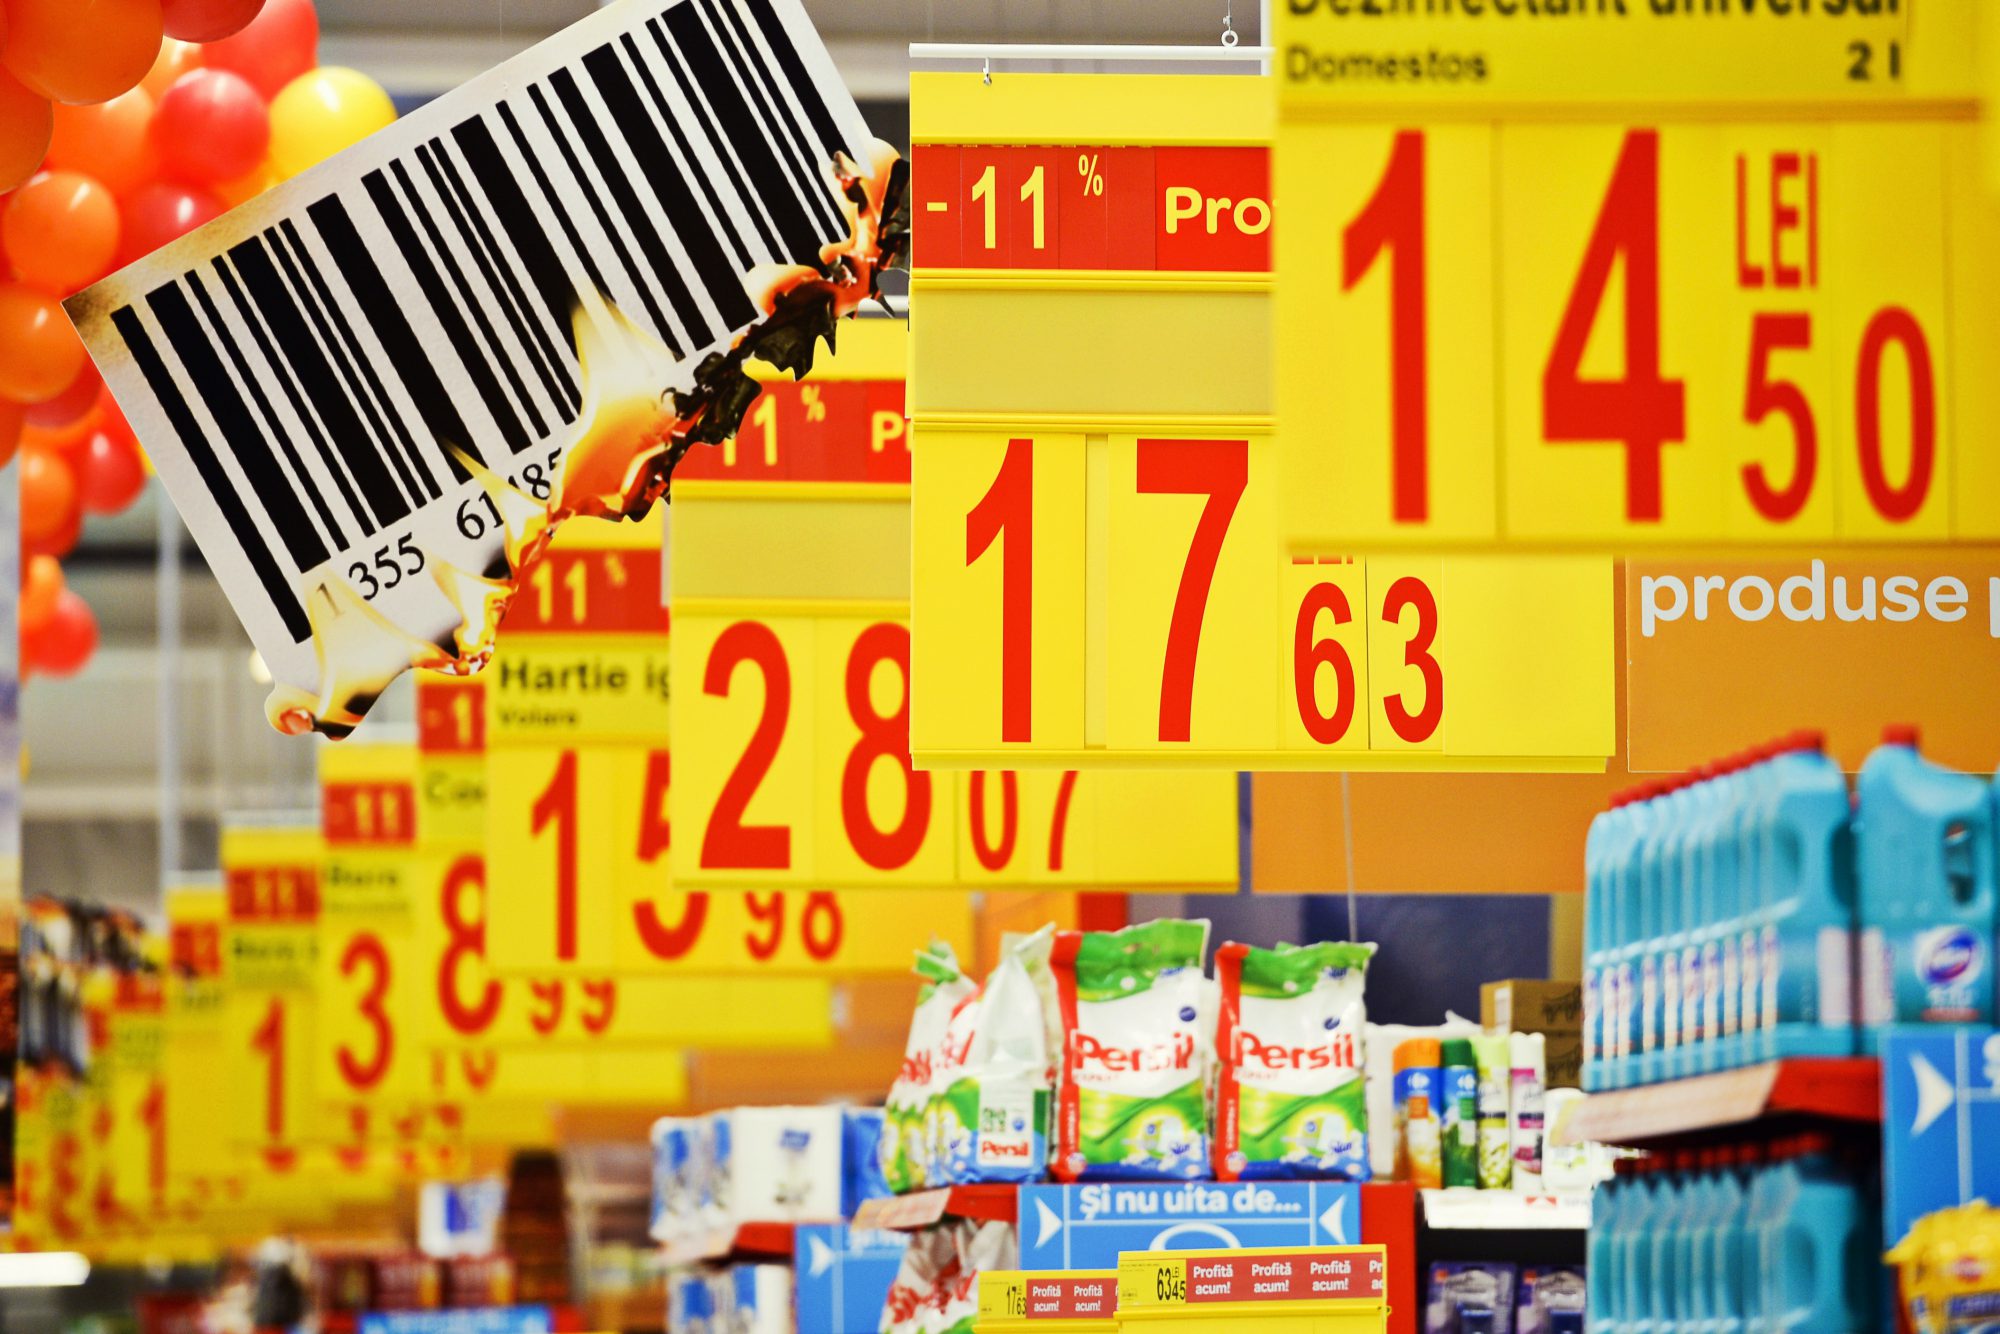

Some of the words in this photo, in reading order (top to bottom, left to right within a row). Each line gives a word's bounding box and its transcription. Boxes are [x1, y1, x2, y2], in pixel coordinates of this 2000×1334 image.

[1286, 47, 1487, 81] Domestos
[1846, 40, 1873, 81] 2
[1165, 186, 1279, 235] Pro
[1736, 152, 1818, 290] LEI
[1341, 129, 1687, 523] 14
[1740, 307, 1936, 524] 50
[348, 532, 425, 601] 355
[966, 438, 1249, 743] 17
[1294, 576, 1443, 745] 63
[1641, 558, 1969, 638] produse
[500, 660, 627, 691] Hartie
[700, 620, 932, 871] 28
[336, 931, 395, 1092] 3
[1073, 1032, 1195, 1072] Persil
[1233, 1032, 1354, 1070] Persil
[981, 1140, 1029, 1158] Persil
[1115, 1189, 1159, 1214] nu
[1163, 1182, 1228, 1214] uita
[1157, 1268, 1172, 1301] 63
[1172, 1280, 1186, 1300] 45
[1193, 1264, 1233, 1278] Profită
[1252, 1262, 1292, 1277] Profită
[1310, 1260, 1351, 1275] Profită
[1312, 1278, 1348, 1291] acum!
[1195, 1283, 1231, 1295] acum!
[1254, 1280, 1289, 1293] acum!
[1034, 1302, 1059, 1311] acum!
[1075, 1301, 1100, 1311] acum!
